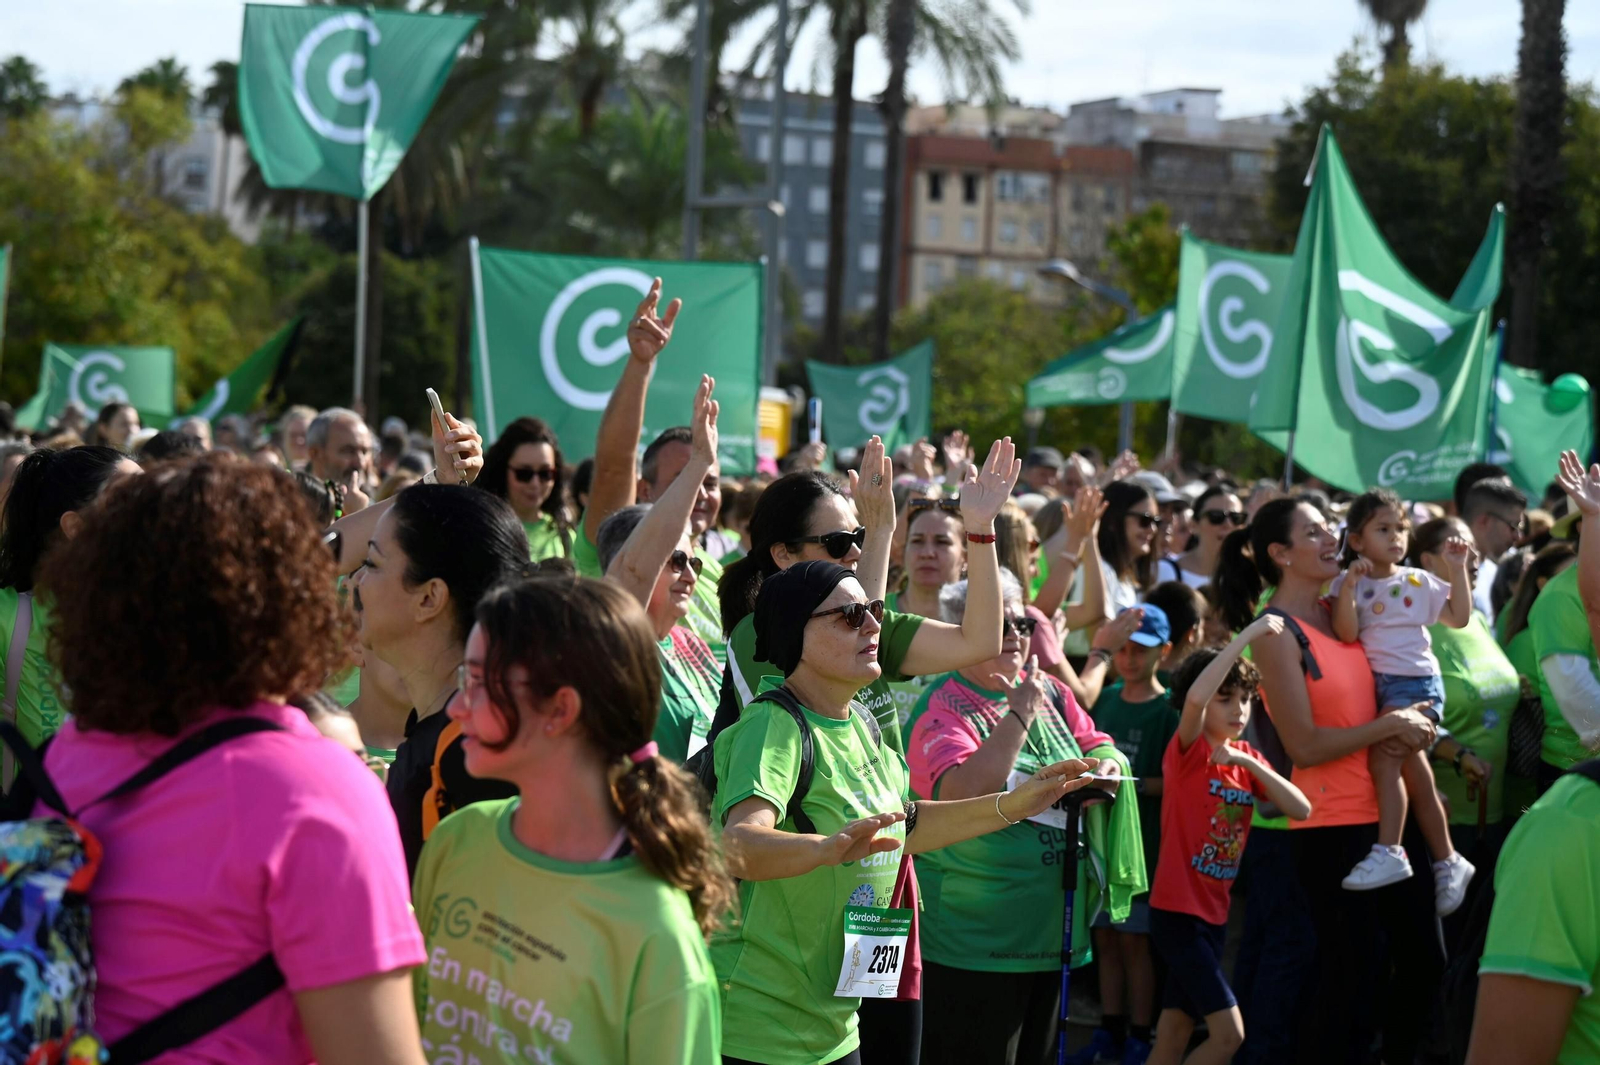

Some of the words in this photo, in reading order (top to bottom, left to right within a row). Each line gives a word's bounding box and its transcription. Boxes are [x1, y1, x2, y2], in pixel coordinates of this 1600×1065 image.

[848, 911, 881, 923] Córdoba
[867, 945, 900, 974] 2374
[428, 946, 461, 985] En
[465, 967, 573, 1044] marcha
